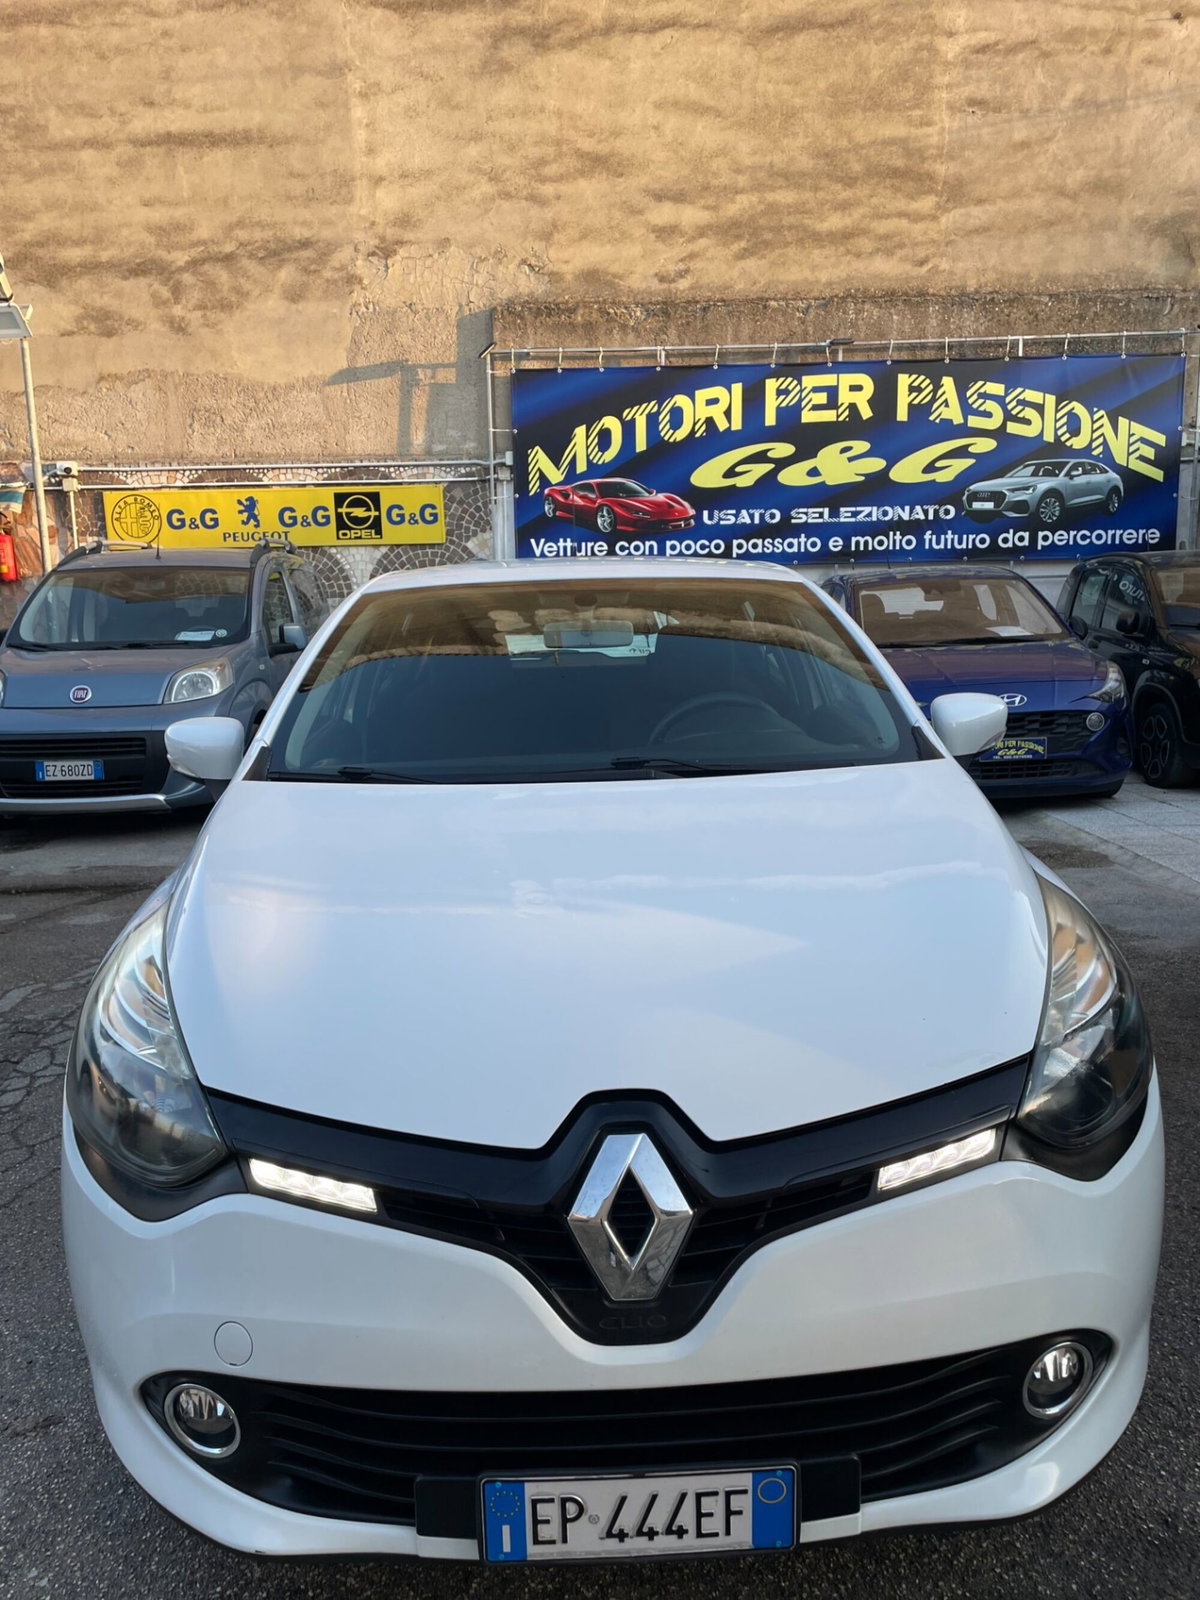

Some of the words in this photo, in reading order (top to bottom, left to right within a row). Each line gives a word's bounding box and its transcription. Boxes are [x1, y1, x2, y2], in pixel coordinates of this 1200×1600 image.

[528, 382, 743, 496] MOTORI
[764, 373, 875, 427] PER
[896, 373, 1167, 482] PASSIONE
[690, 436, 998, 488] G&G
[166, 508, 220, 530] G&G
[278, 505, 331, 528] G&G
[386, 503, 439, 526] G&G
[703, 507, 781, 525] USATO
[790, 504, 956, 524] SELEZIONATO
[338, 529, 381, 539] OPEL
[530, 538, 608, 557] Vetture
[615, 539, 658, 556] con
[666, 538, 725, 557] poco
[732, 533, 822, 558] passato
[828, 536, 844, 552] e
[851, 531, 917, 551] molto
[924, 529, 991, 551] futuro
[998, 528, 1030, 548] da
[1037, 528, 1160, 550] percorrere
[74, 689, 88, 699] FIAT
[599, 1314, 669, 1330] CLIO
